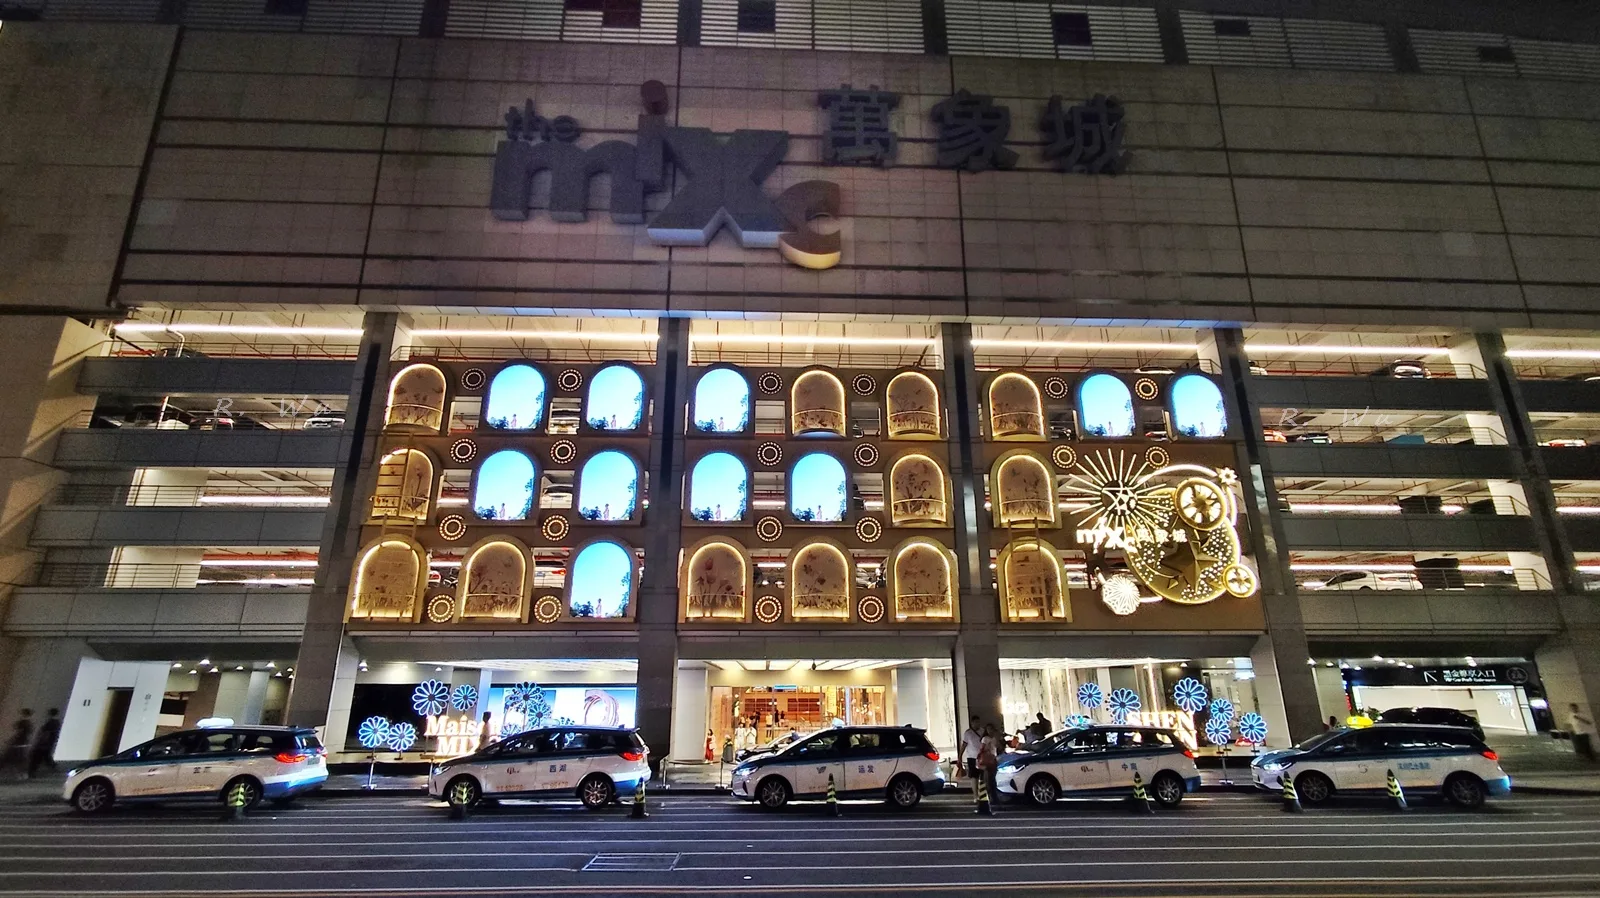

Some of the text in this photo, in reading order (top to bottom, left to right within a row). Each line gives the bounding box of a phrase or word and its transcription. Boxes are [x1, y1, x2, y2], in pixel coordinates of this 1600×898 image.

[505, 98, 580, 143] the
[816, 84, 1136, 176] 萬象城
